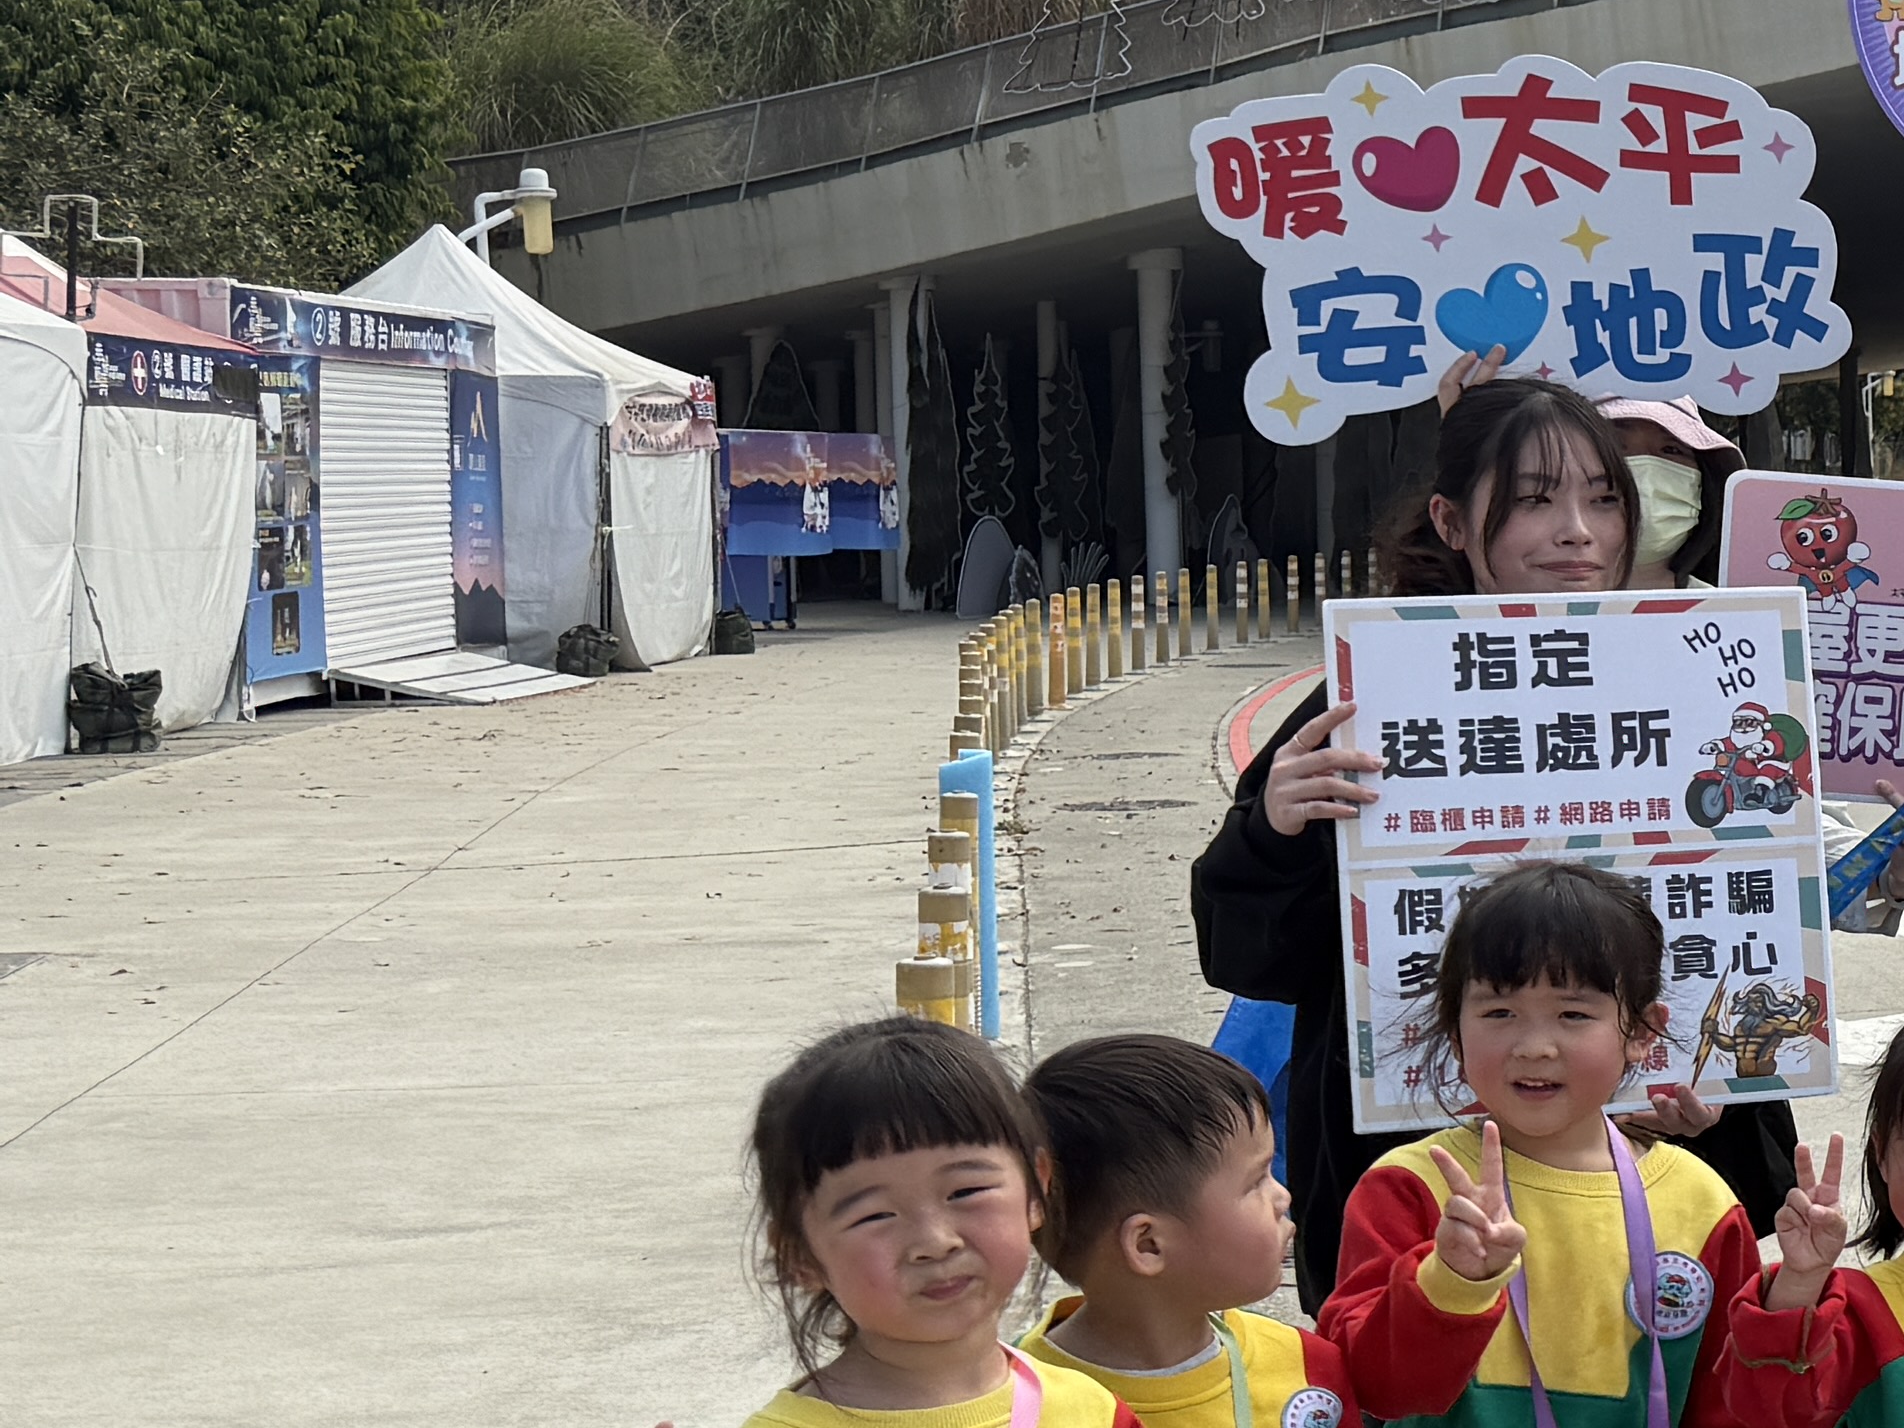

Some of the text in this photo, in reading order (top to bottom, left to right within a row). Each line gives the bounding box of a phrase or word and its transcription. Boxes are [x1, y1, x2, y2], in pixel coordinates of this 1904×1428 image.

[1207, 74, 1746, 242] 暖 太平
[1289, 227, 1830, 387] 安 地政
[1452, 630, 1595, 693] 指定
[1683, 623, 1723, 654] HO
[1718, 637, 1756, 667] HO
[1717, 666, 1755, 698] HO
[1381, 708, 1673, 780] 送達處所
